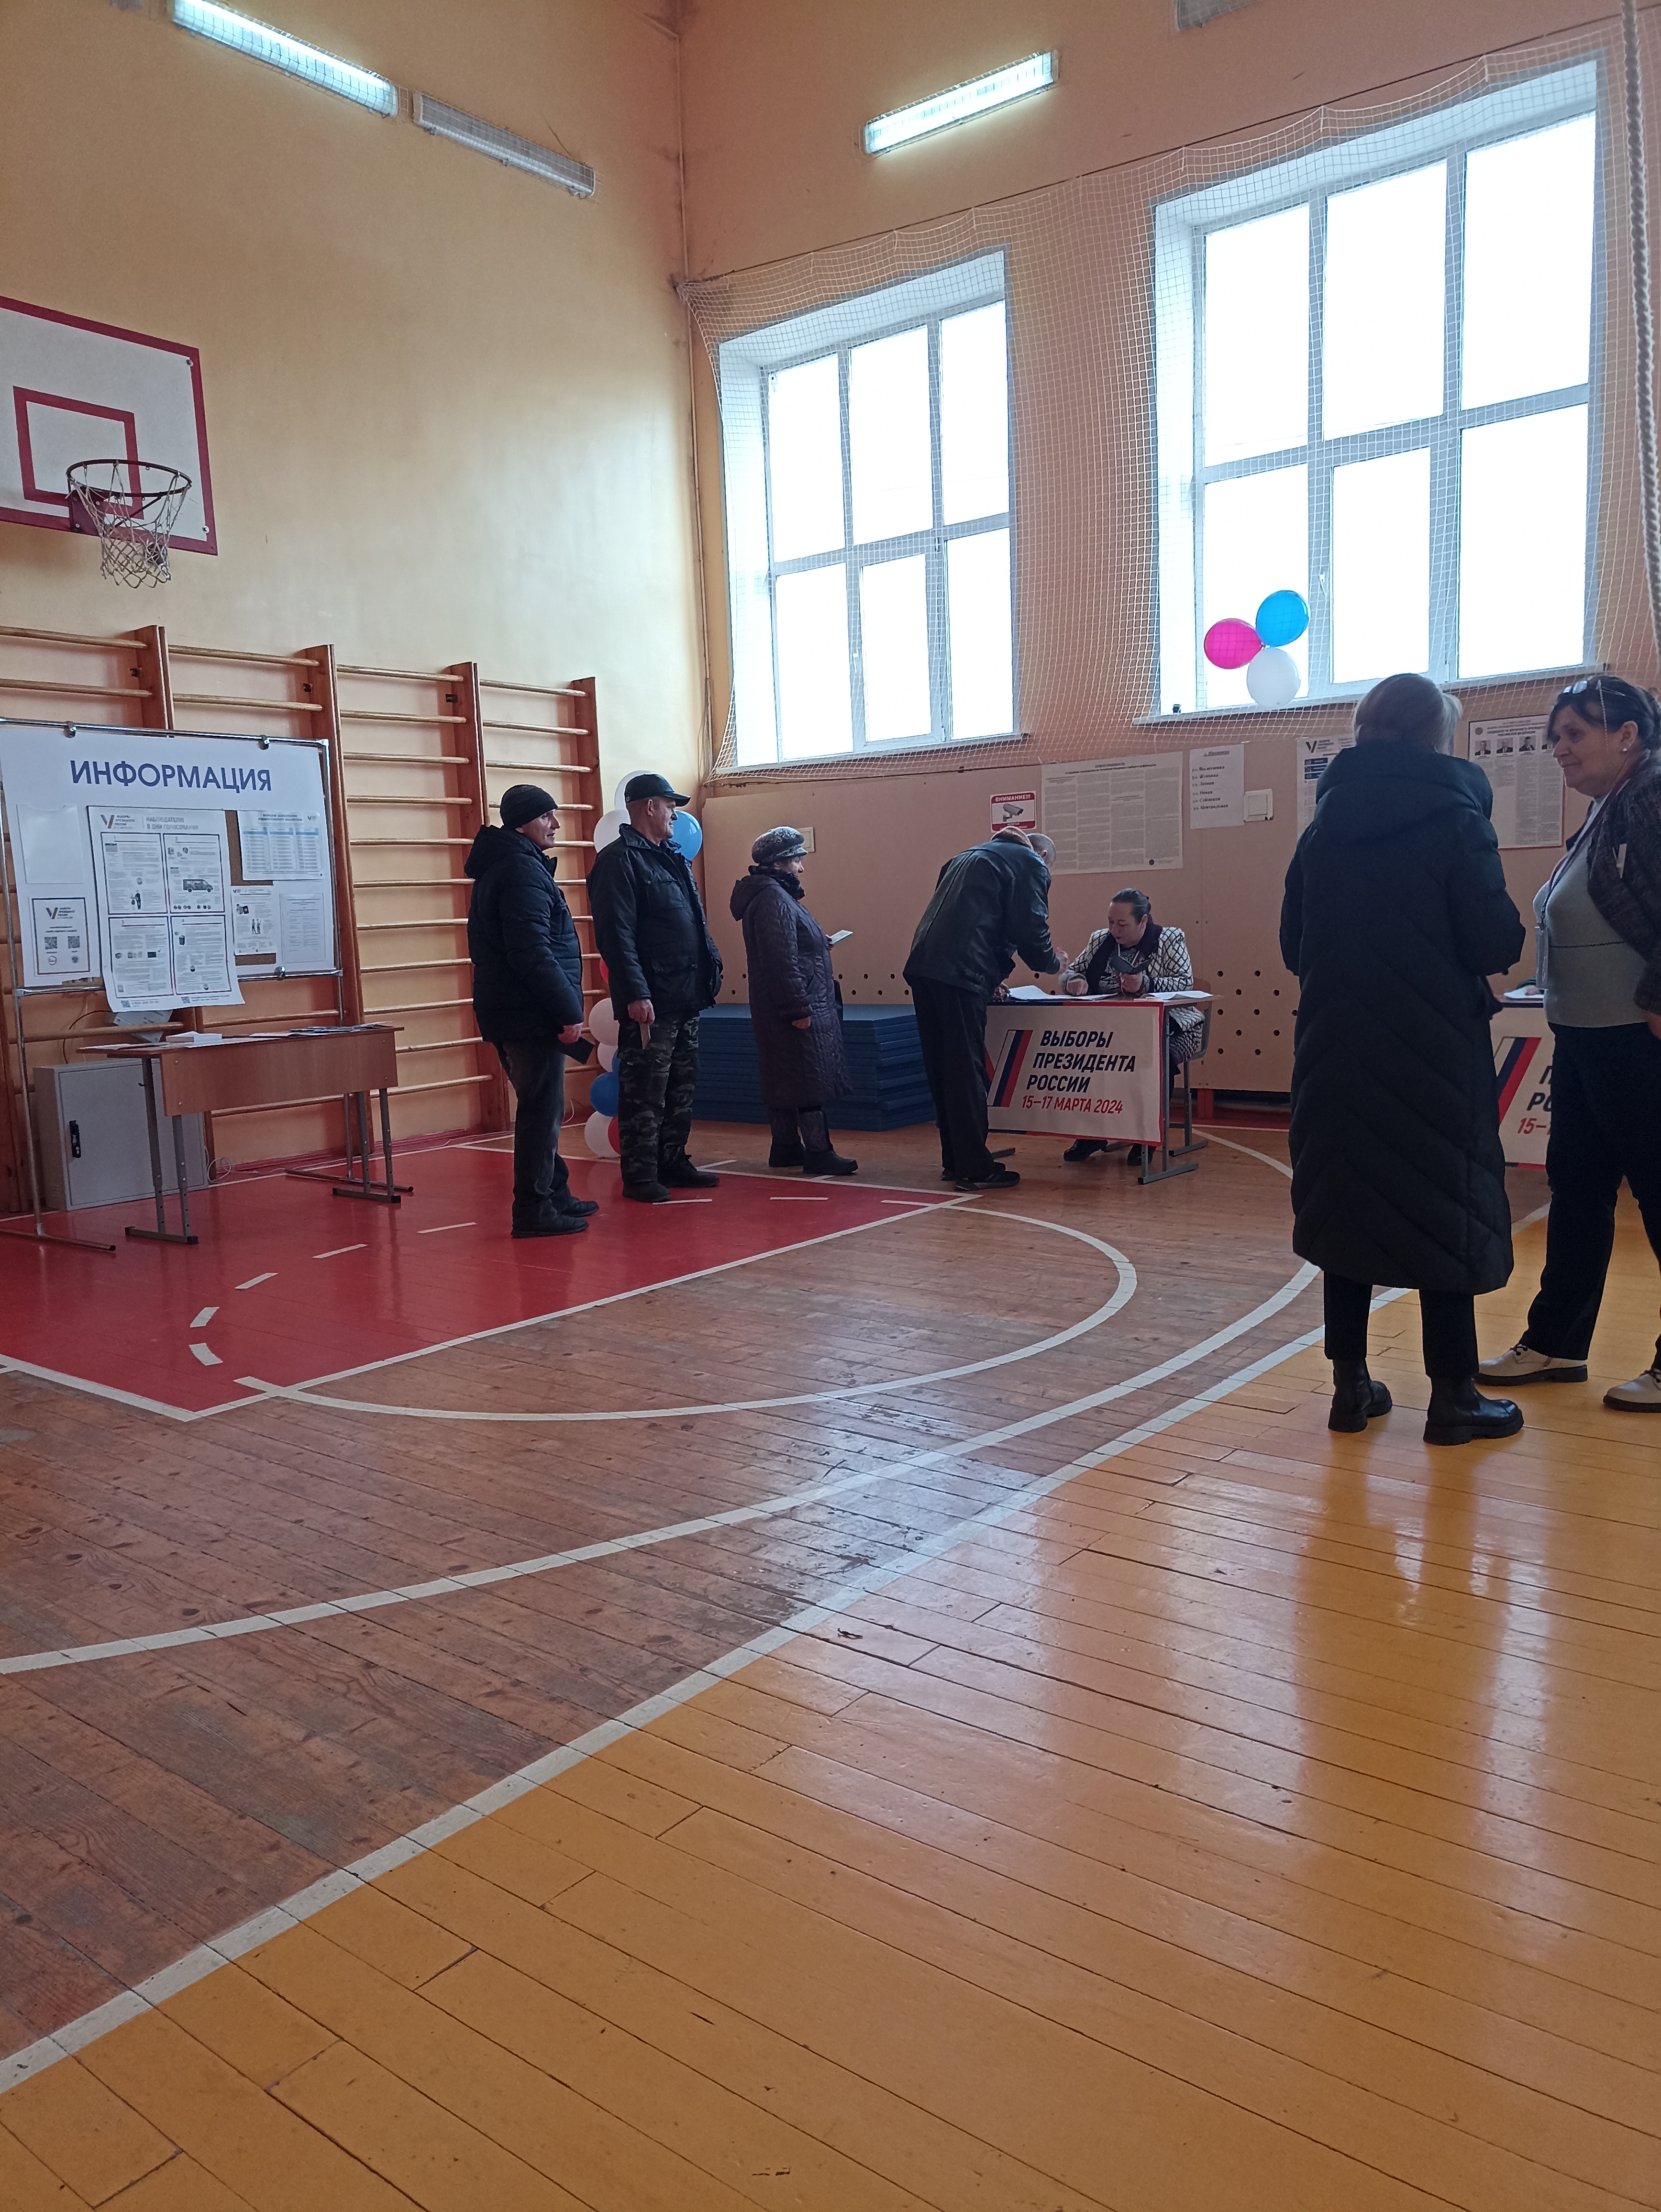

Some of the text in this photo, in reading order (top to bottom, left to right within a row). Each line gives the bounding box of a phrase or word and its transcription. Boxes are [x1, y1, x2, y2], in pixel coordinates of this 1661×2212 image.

[70, 760, 271, 793] ИНФОРМАЦИЯ
[1040, 1030, 1114, 1048] ВЫБОРЫ
[1032, 1052, 1136, 1073] ПРЕЗИДЕНТА
[1026, 1074, 1091, 1093] РОССИИ
[1053, 1097, 1092, 1112] МАРТА
[1093, 1099, 1123, 1114] 2024
